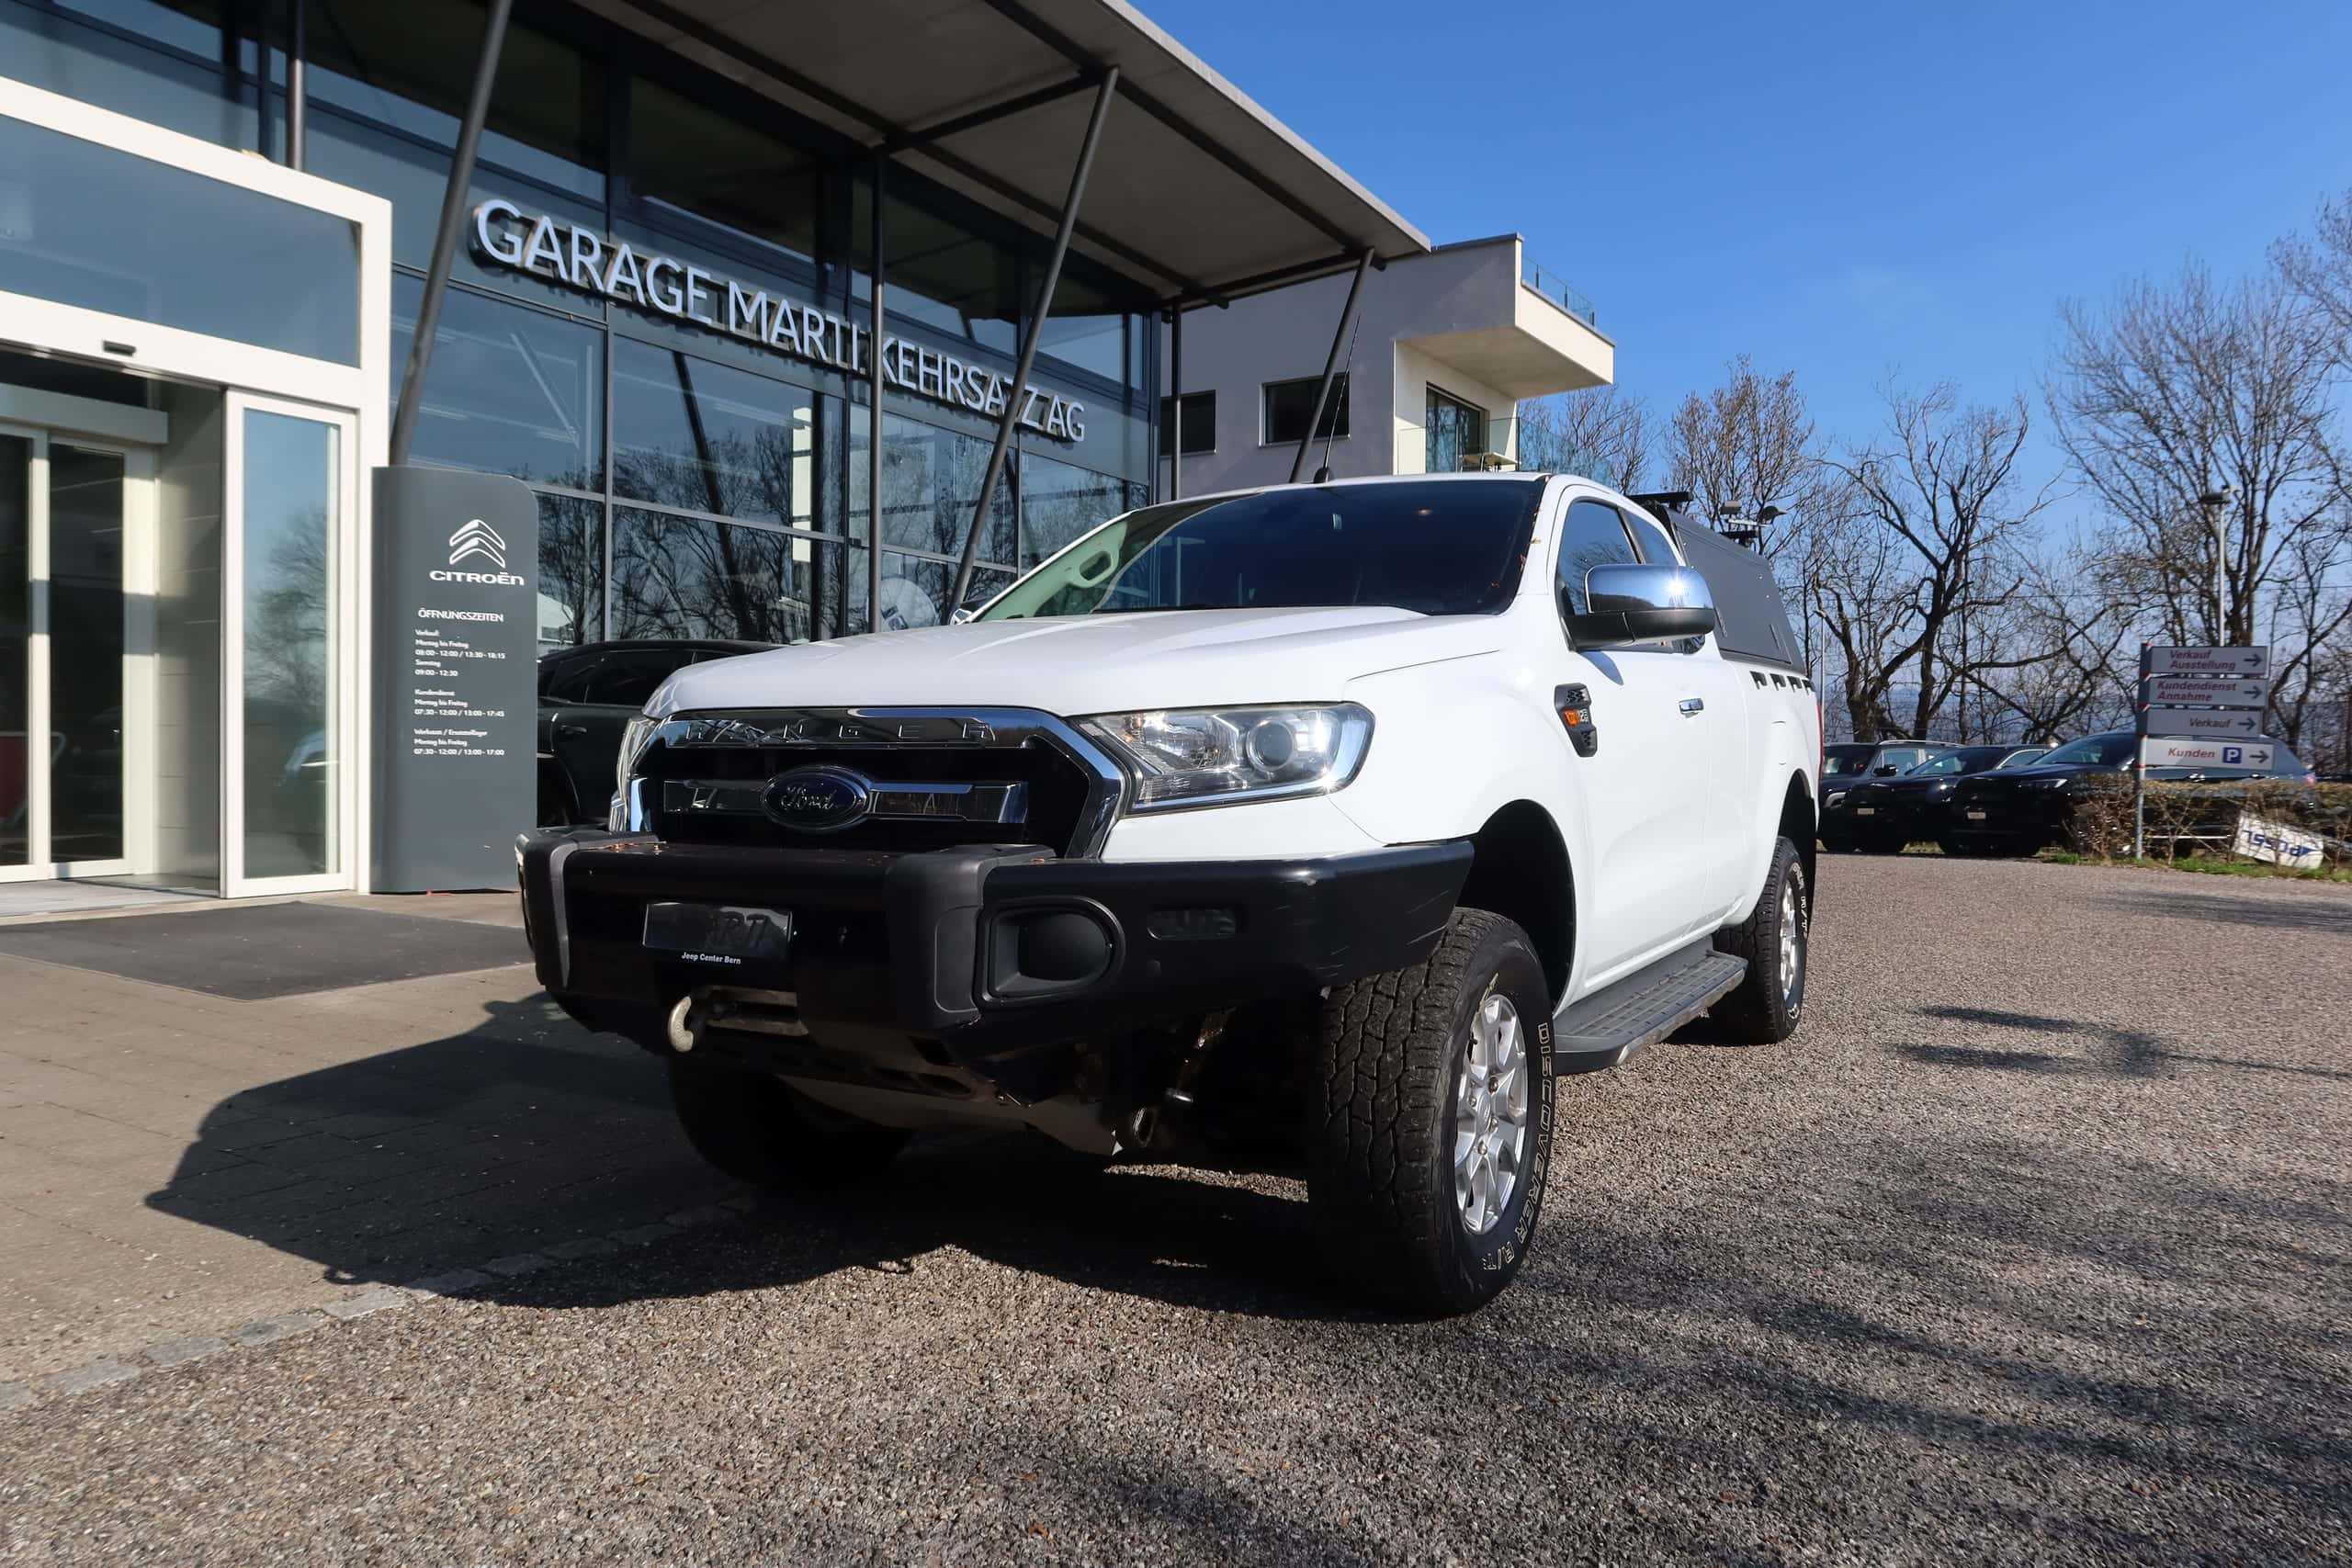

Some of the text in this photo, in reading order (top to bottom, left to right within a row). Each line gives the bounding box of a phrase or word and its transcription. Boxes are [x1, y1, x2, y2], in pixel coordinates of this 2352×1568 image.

[476, 198, 713, 324] GARAGE
[1046, 395, 1085, 442] AG
[418, 607, 503, 622] ÖFFNUNGSZEITEN
[2169, 649, 2212, 660] Verkauf
[2170, 660, 2236, 671] Ausstellung
[2157, 681, 2237, 691] Kundendienst
[2157, 691, 2213, 701] Annahme
[2189, 718, 2233, 728] Verkauf
[2168, 748, 2216, 758] Kunden
[779, 785, 838, 810] Ford
[682, 952, 741, 964] Jeep Center Bern
[1516, 1021, 1554, 1244] DISCOVERER
